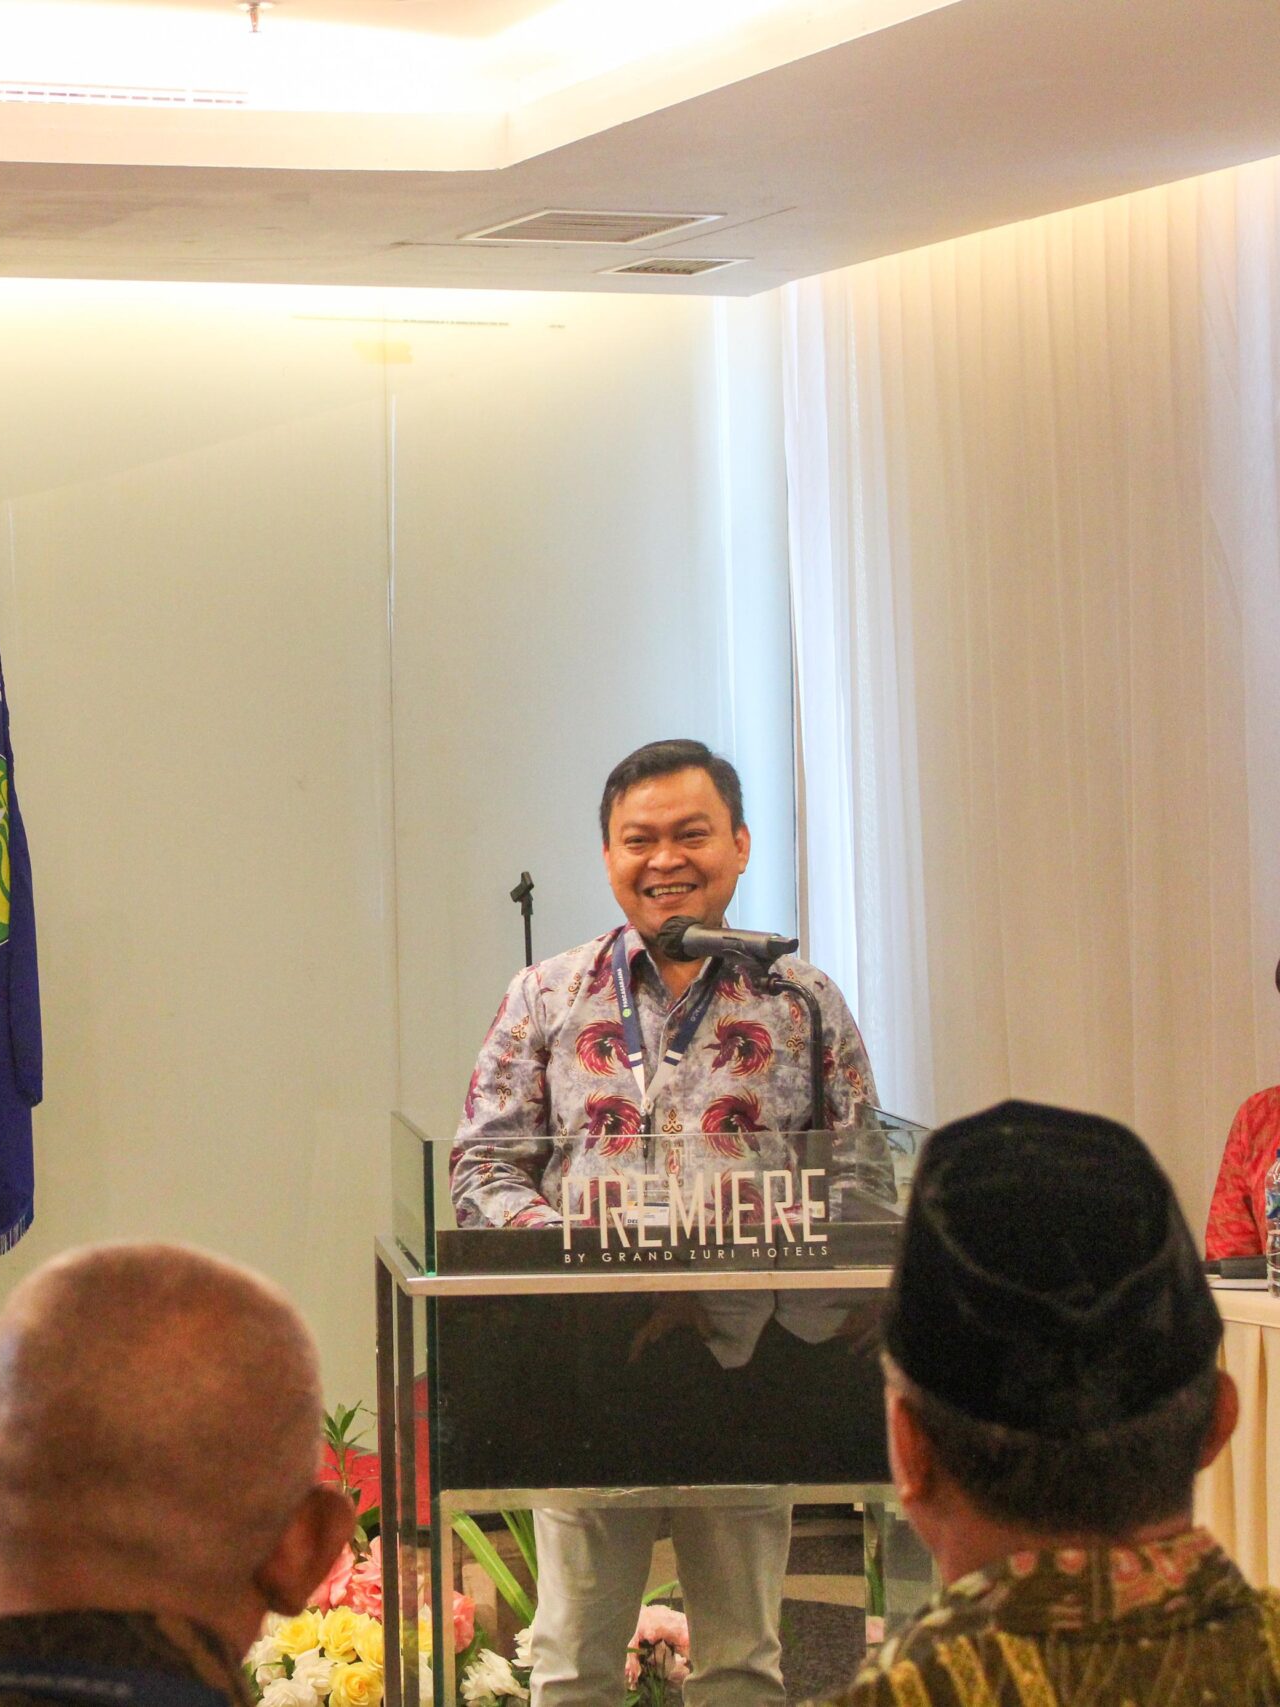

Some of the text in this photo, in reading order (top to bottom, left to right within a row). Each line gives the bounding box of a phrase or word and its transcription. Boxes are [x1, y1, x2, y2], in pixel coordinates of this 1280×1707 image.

[561, 1169, 828, 1250] PREMIERE
[564, 1246, 828, 1263] BY GRAND ZURI HOTELS
